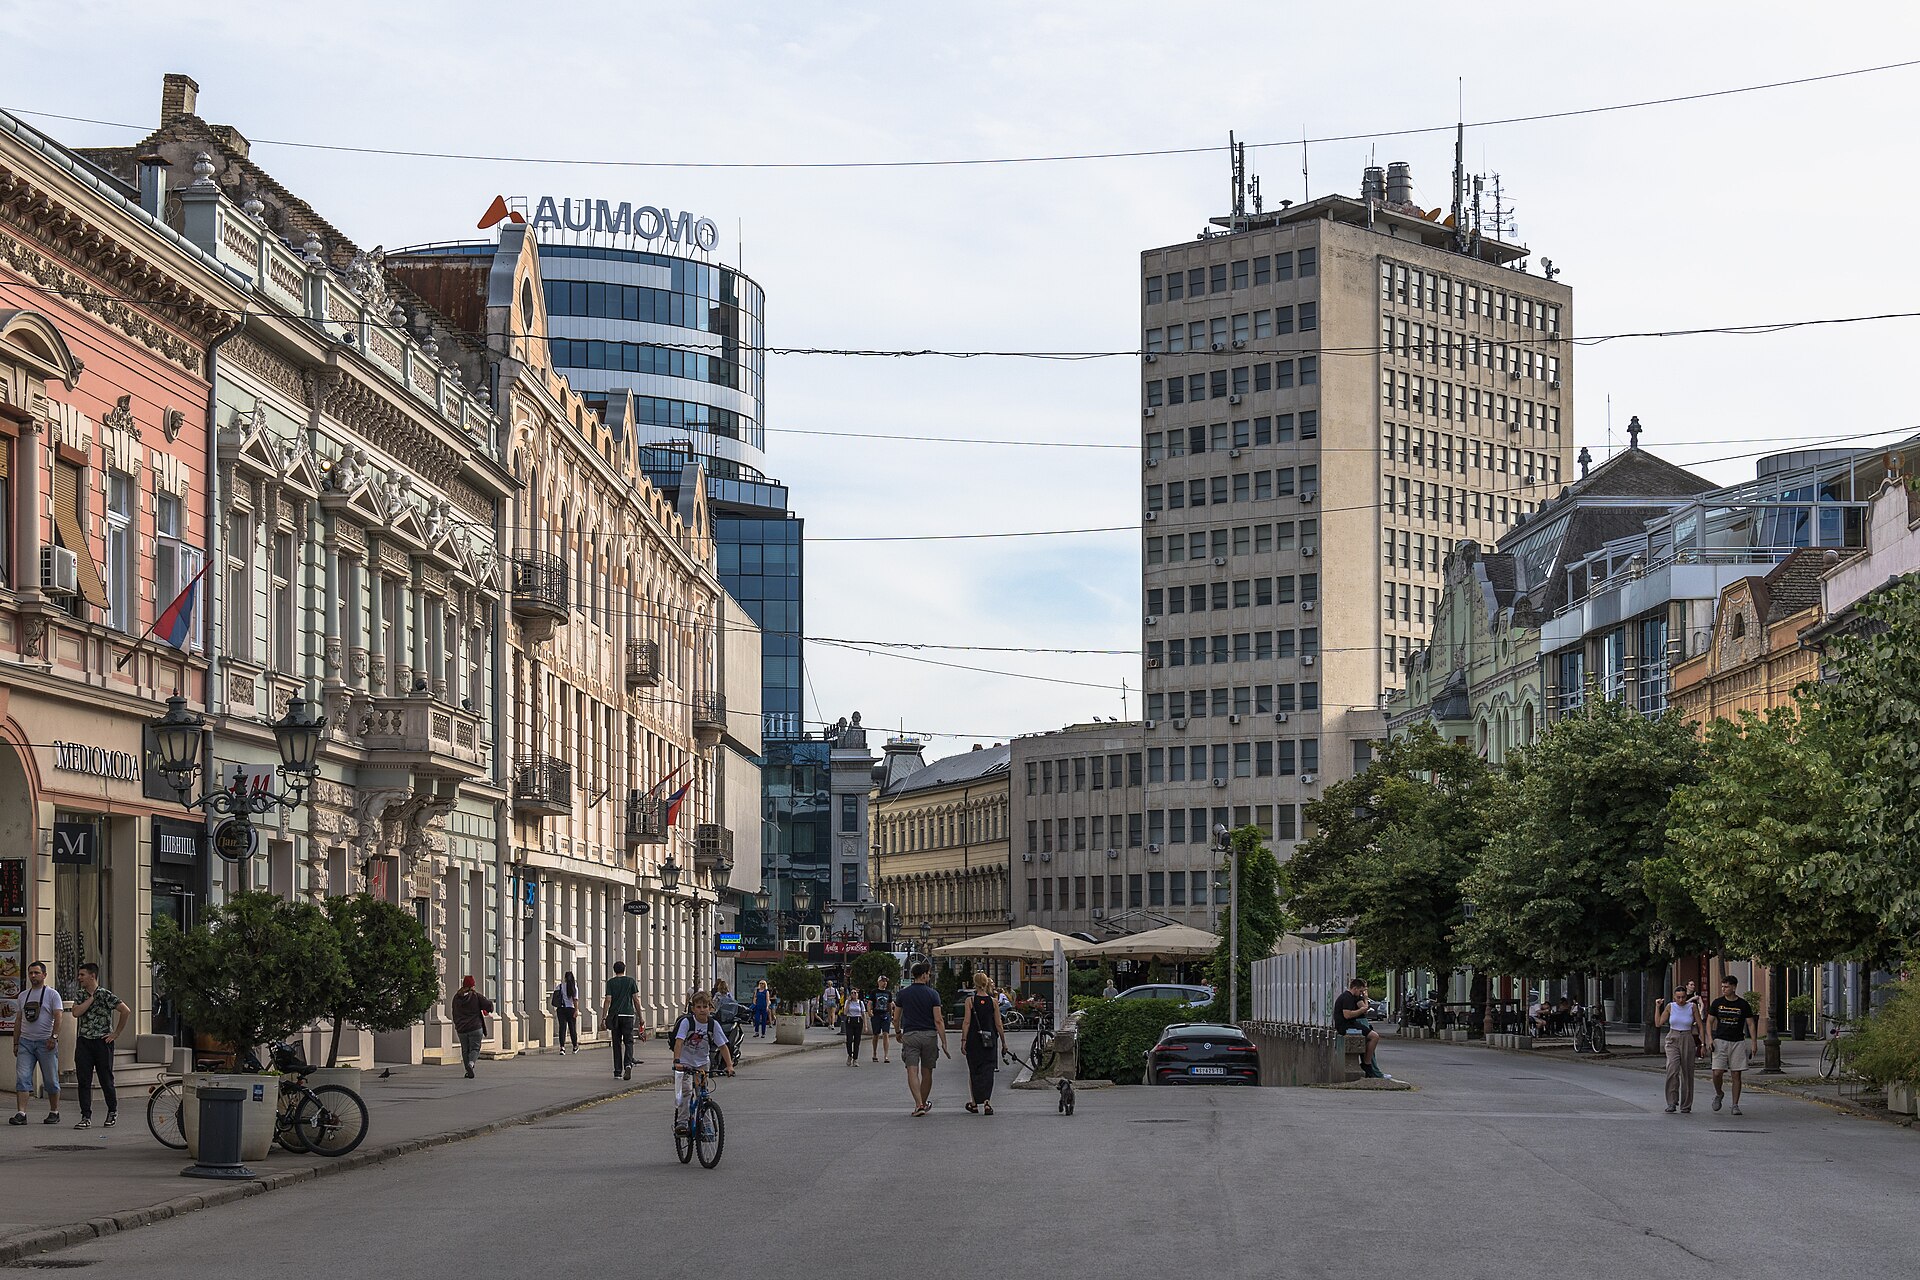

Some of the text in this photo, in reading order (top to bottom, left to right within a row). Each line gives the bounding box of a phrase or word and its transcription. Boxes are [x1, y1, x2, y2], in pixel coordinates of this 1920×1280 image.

[533, 196, 720, 252] AUMOVIO
[54, 740, 141, 782] MEDIOMODA
[160, 834, 197, 858] ПИВНИЦА
